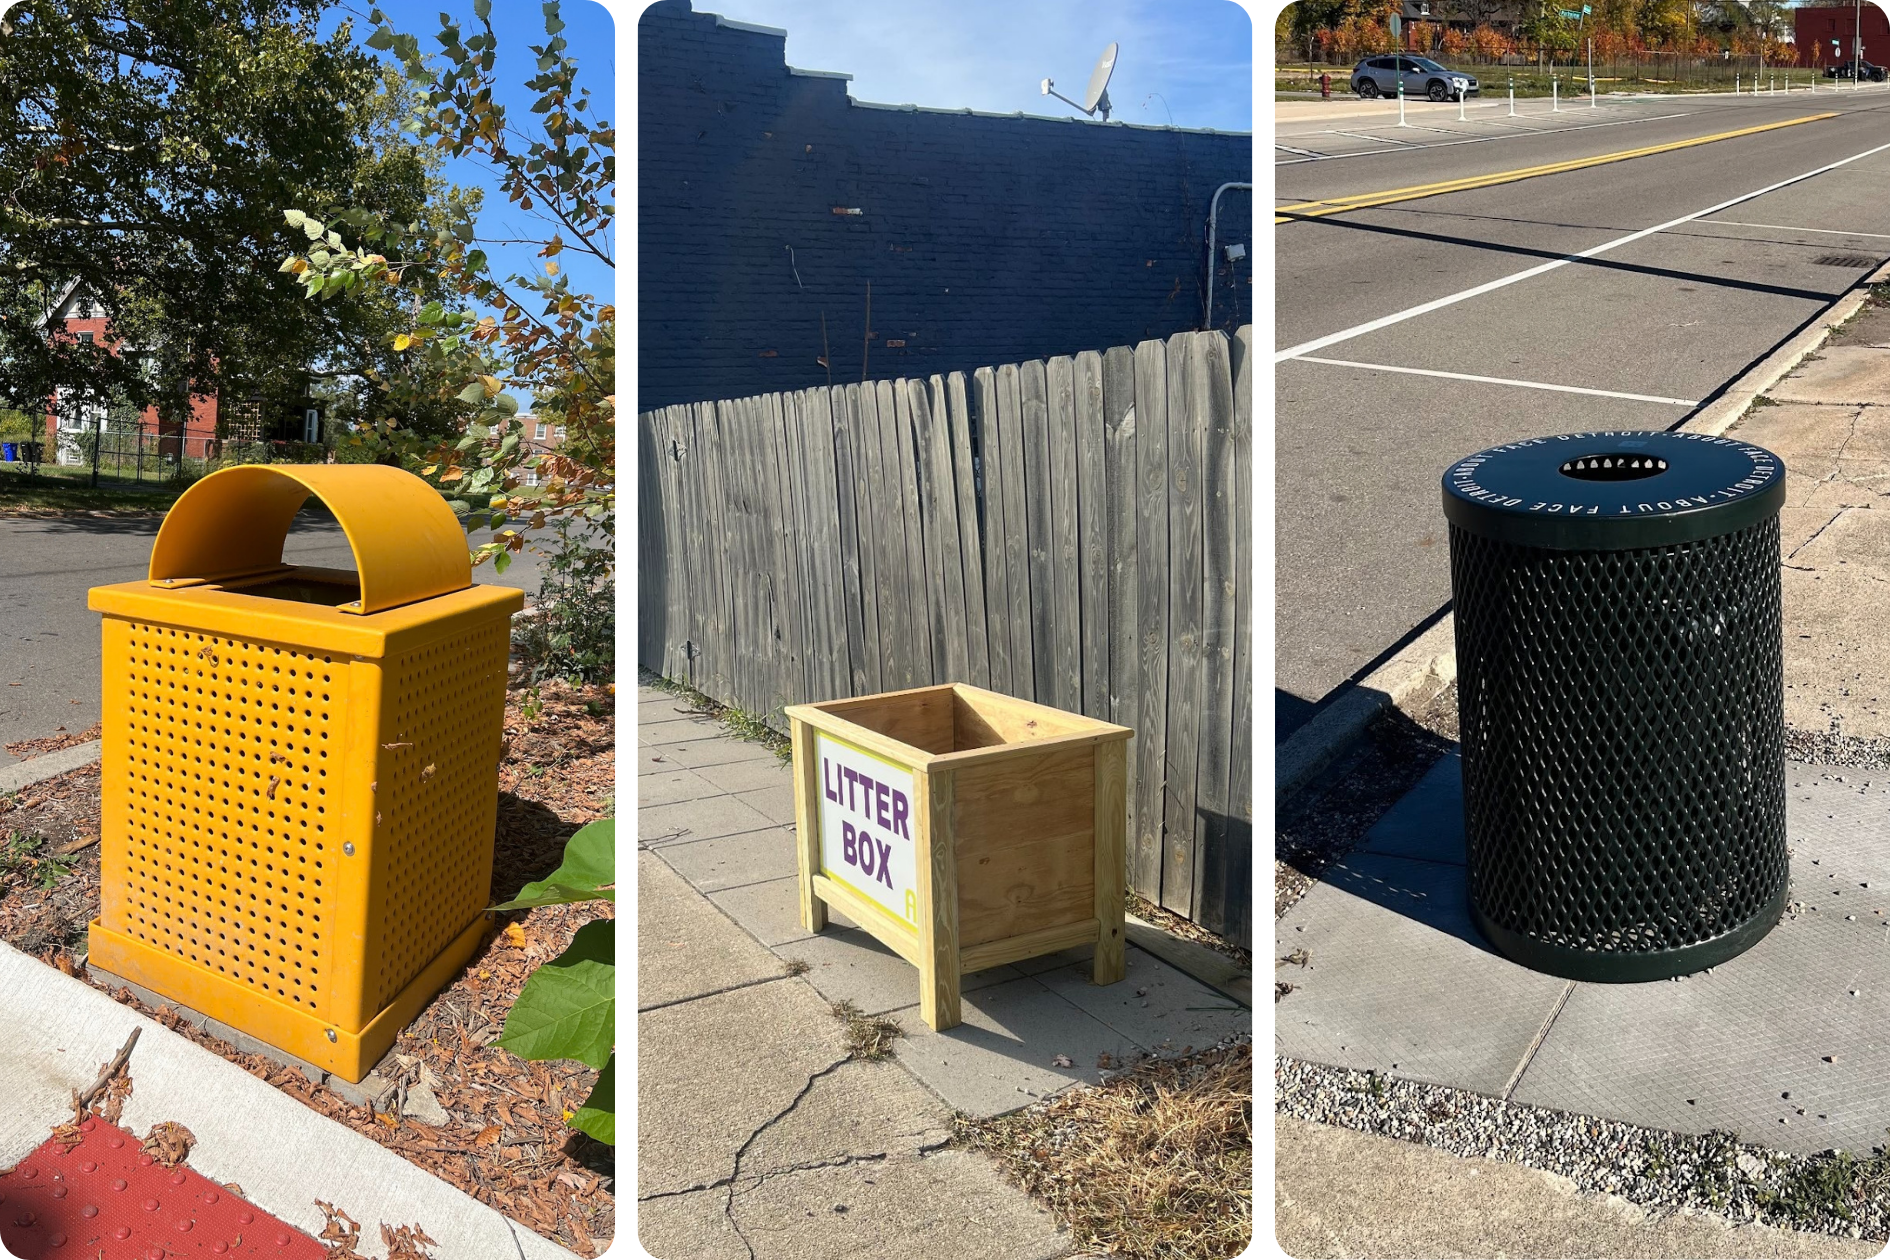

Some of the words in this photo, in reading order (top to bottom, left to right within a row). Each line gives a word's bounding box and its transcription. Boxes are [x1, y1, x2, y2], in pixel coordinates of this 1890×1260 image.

[1672, 432, 1742, 447] ABOUT
[1738, 446, 1774, 463] FACE
[1453, 479, 1522, 507] DETROIT
[1717, 465, 1775, 498] DETROIT
[1529, 502, 1599, 514] FACE
[1619, 495, 1708, 514] ABOUT
[823, 757, 910, 841] LITTER
[842, 819, 894, 891] BOX
